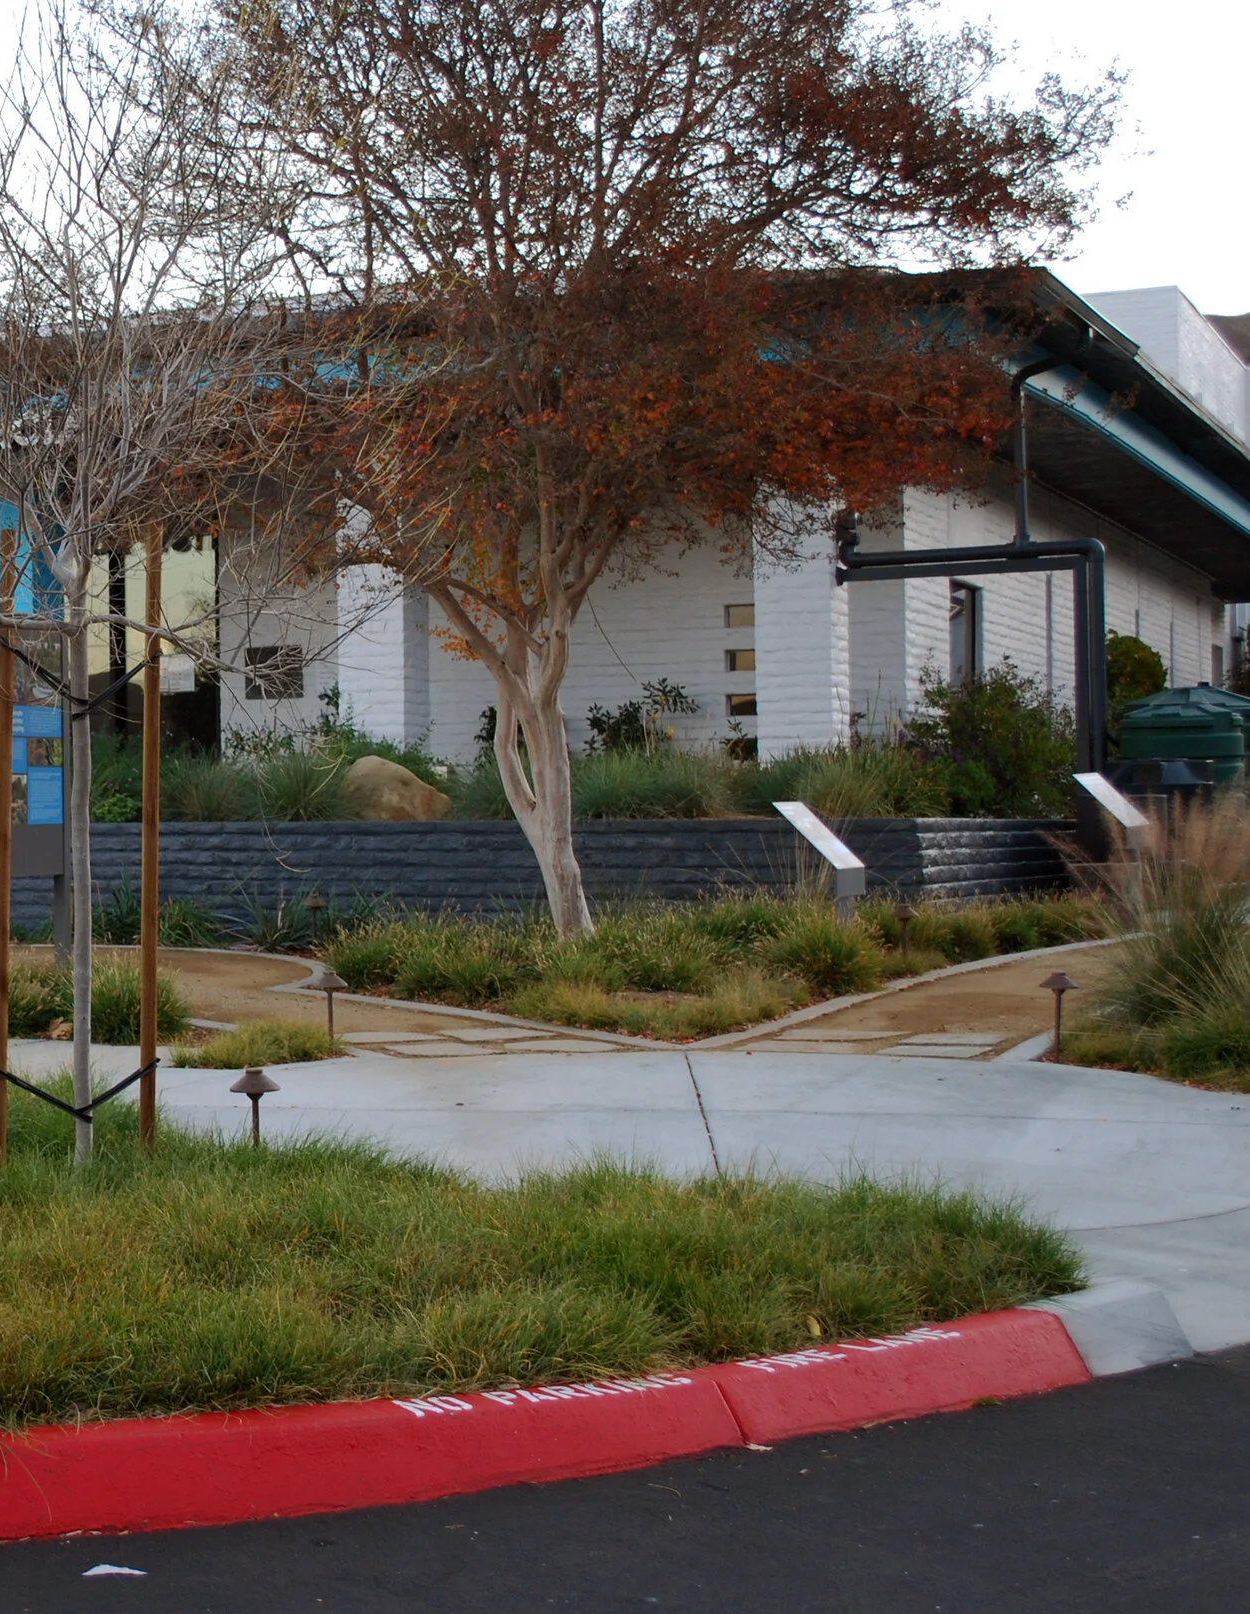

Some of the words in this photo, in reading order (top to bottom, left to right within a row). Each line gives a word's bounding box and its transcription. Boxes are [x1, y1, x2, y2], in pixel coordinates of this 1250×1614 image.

[391, 1396, 473, 1418] NO
[481, 1373, 693, 1406] PARKING
[735, 1349, 847, 1373] FIRE
[837, 1327, 961, 1352] LANE
